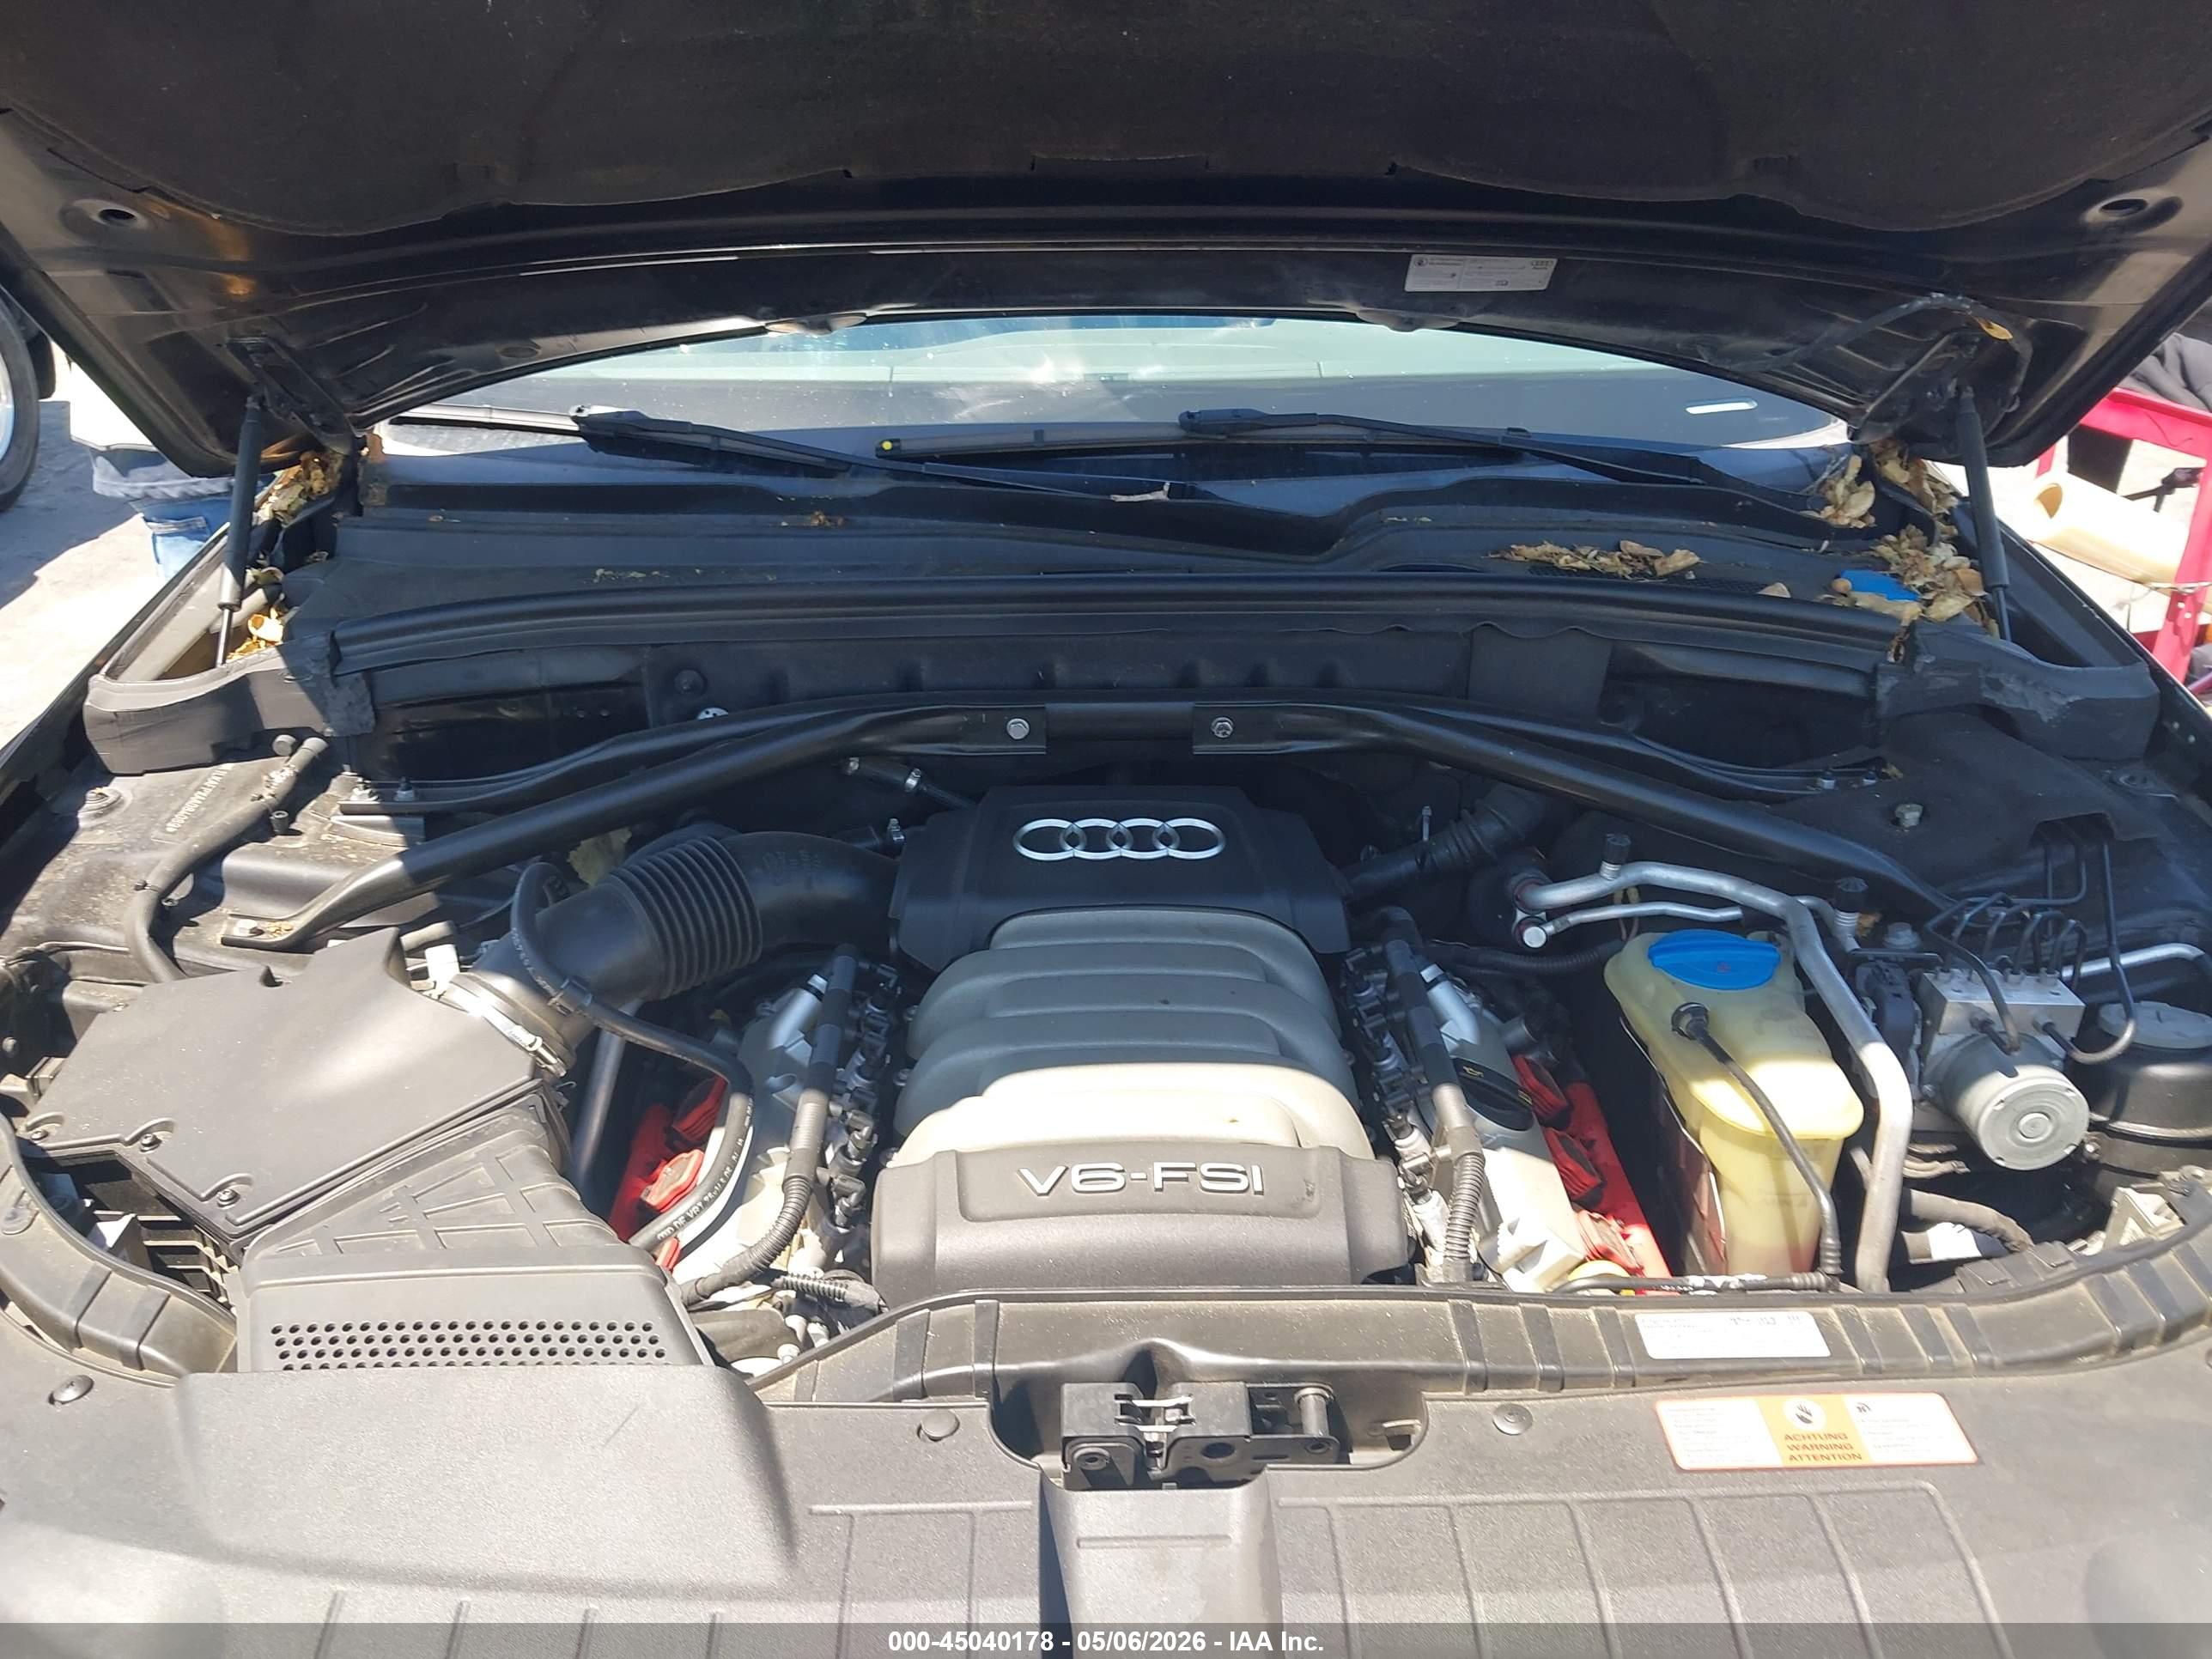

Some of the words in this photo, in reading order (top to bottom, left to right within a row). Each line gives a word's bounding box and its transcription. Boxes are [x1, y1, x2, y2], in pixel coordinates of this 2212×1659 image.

[1017, 1162, 1264, 1196] V6-FSI
[1784, 1431, 1848, 1442] ACHTUNG
[1786, 1443, 1854, 1452] WARNING
[1789, 1452, 1863, 1462] ATTENTION
